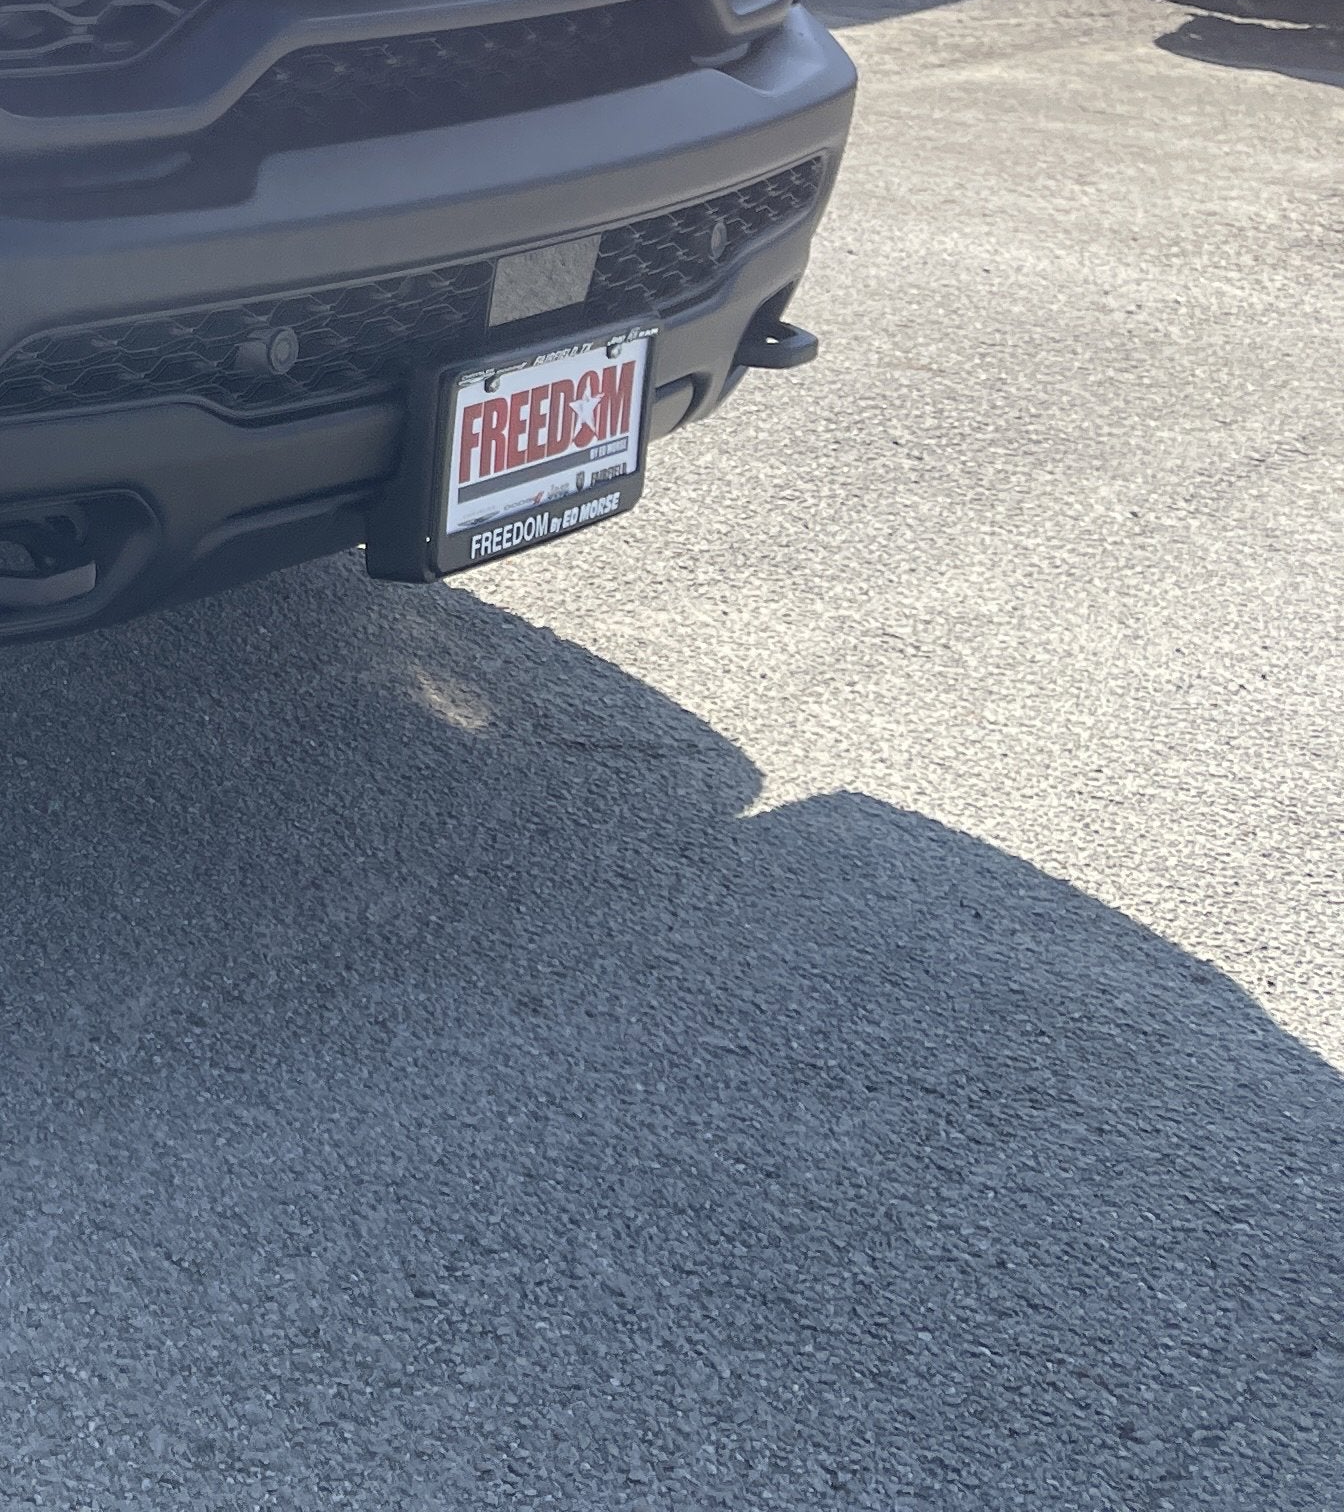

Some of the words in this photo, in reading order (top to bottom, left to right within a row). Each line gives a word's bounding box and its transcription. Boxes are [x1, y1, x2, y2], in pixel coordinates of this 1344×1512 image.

[459, 360, 636, 484] FREEDOM
[470, 512, 549, 560] FREEDOM
[562, 506, 579, 529] ED
[579, 491, 621, 523] MORSE
